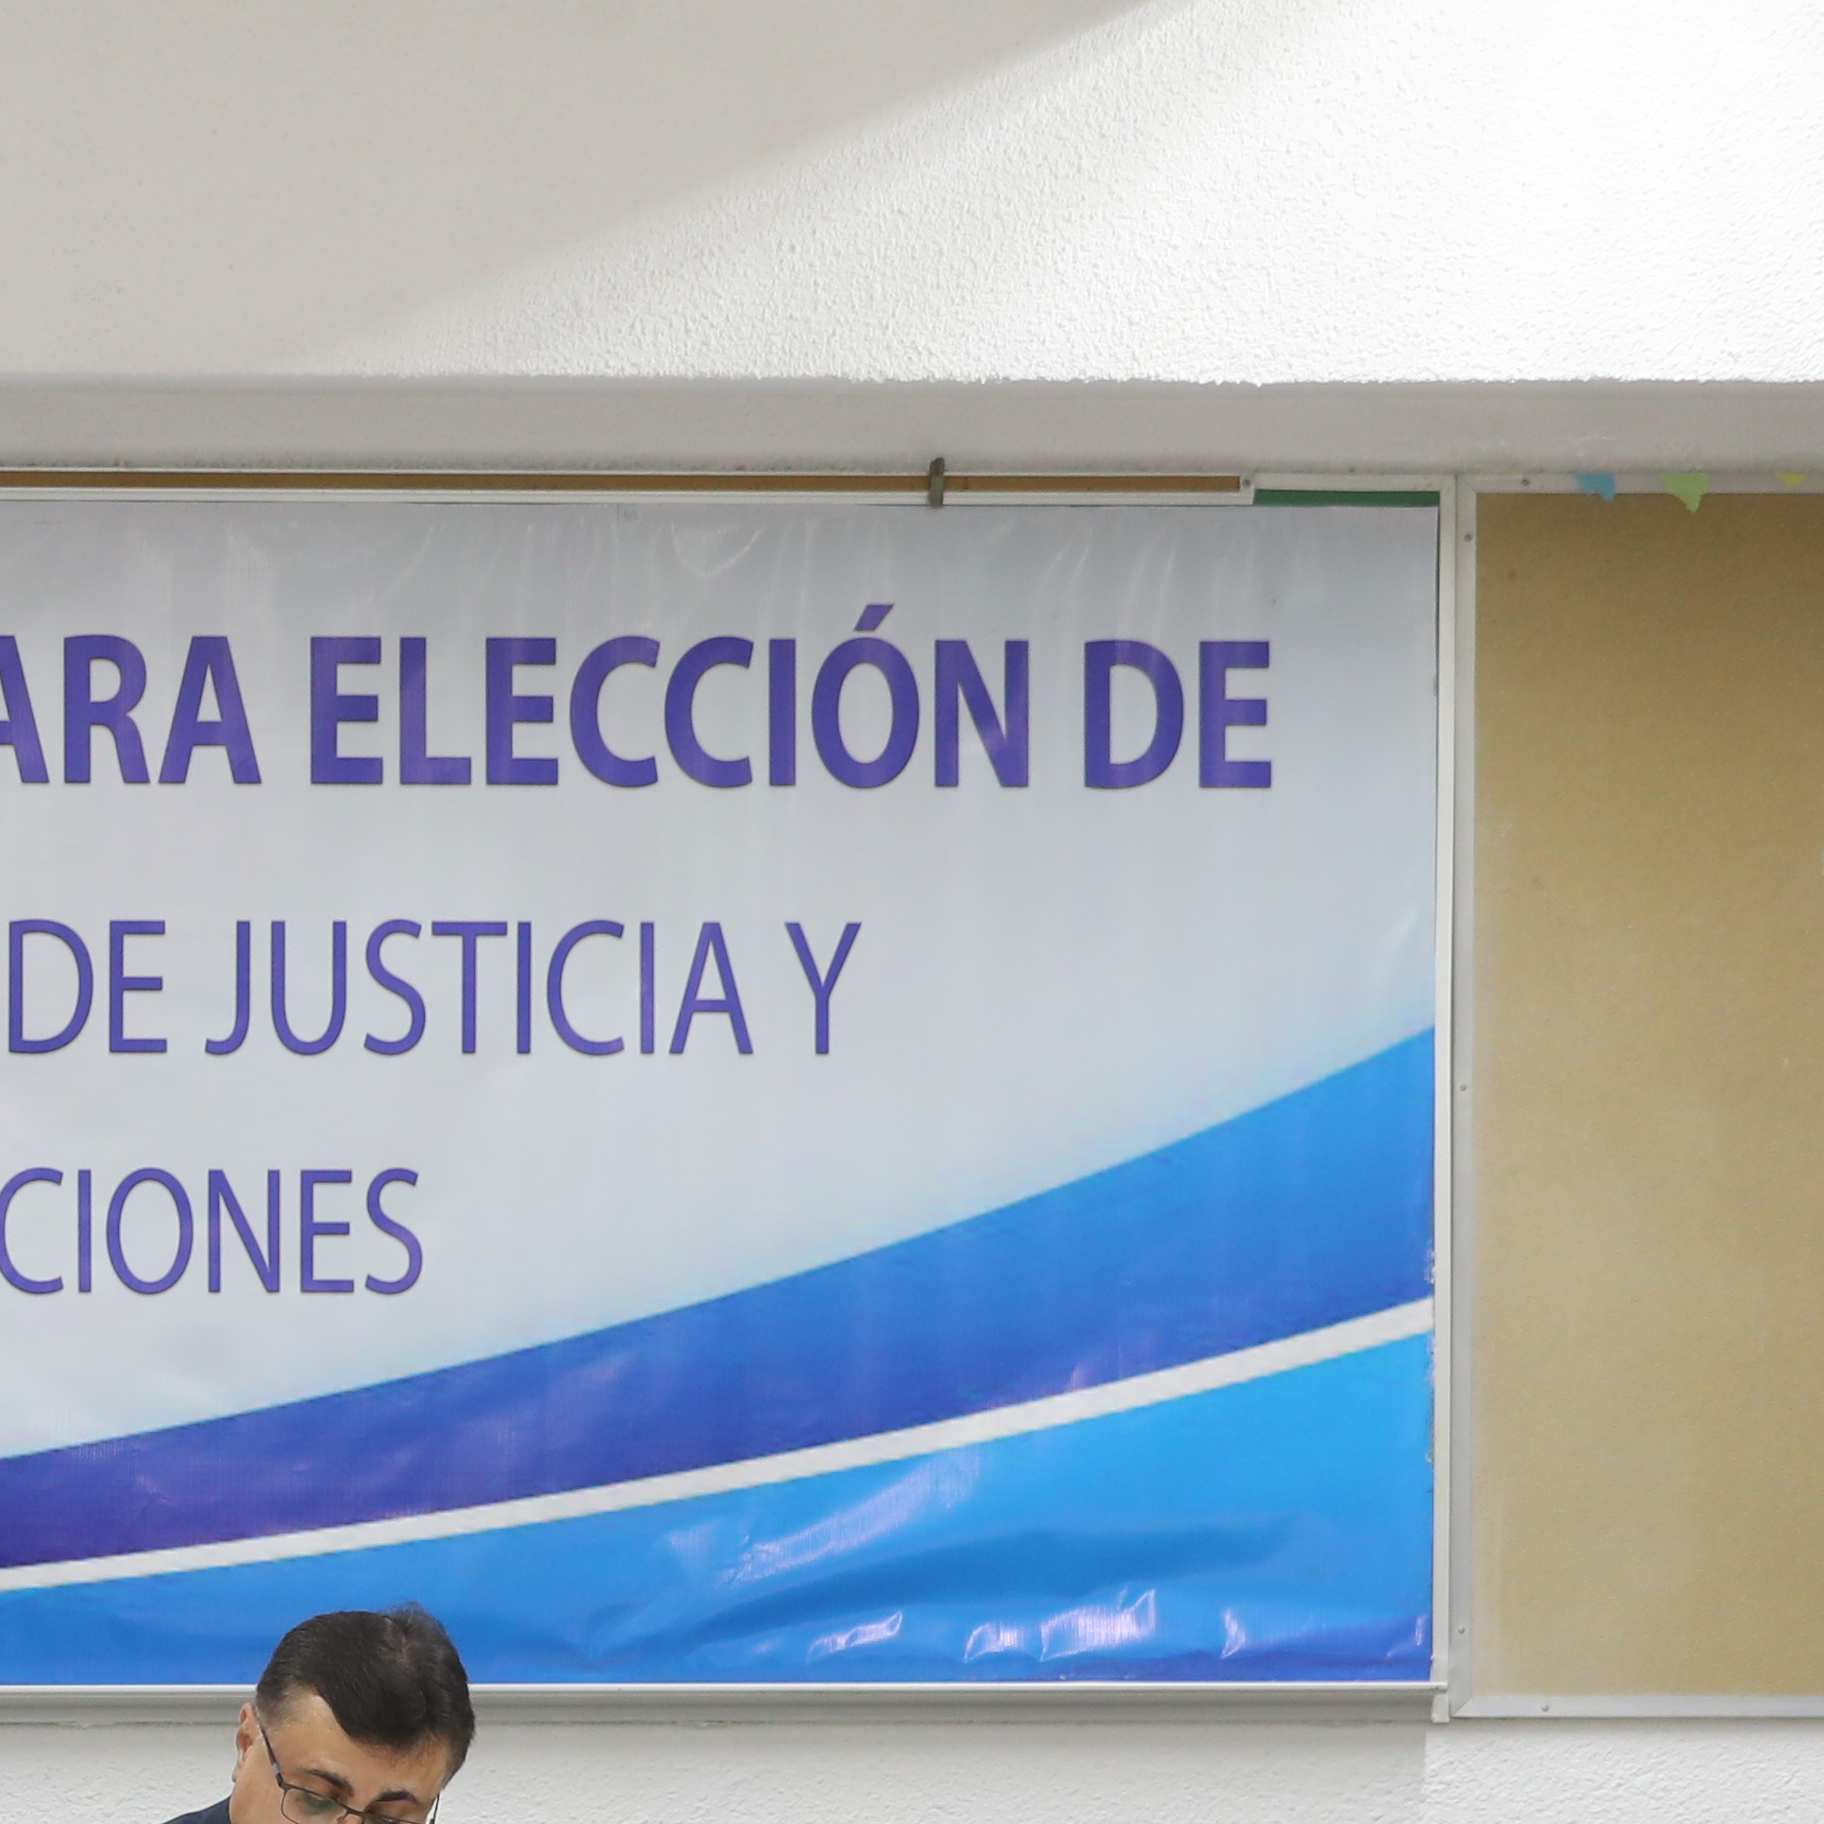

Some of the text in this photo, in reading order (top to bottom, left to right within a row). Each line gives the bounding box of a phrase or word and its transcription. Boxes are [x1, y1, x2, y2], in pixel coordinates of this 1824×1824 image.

[310, 603, 1030, 789] ELECCIÓN
[1083, 638, 1273, 789] DE
[8, 918, 168, 1055] DE
[204, 918, 754, 1057] JUSTICIA
[785, 921, 862, 1055] Y
